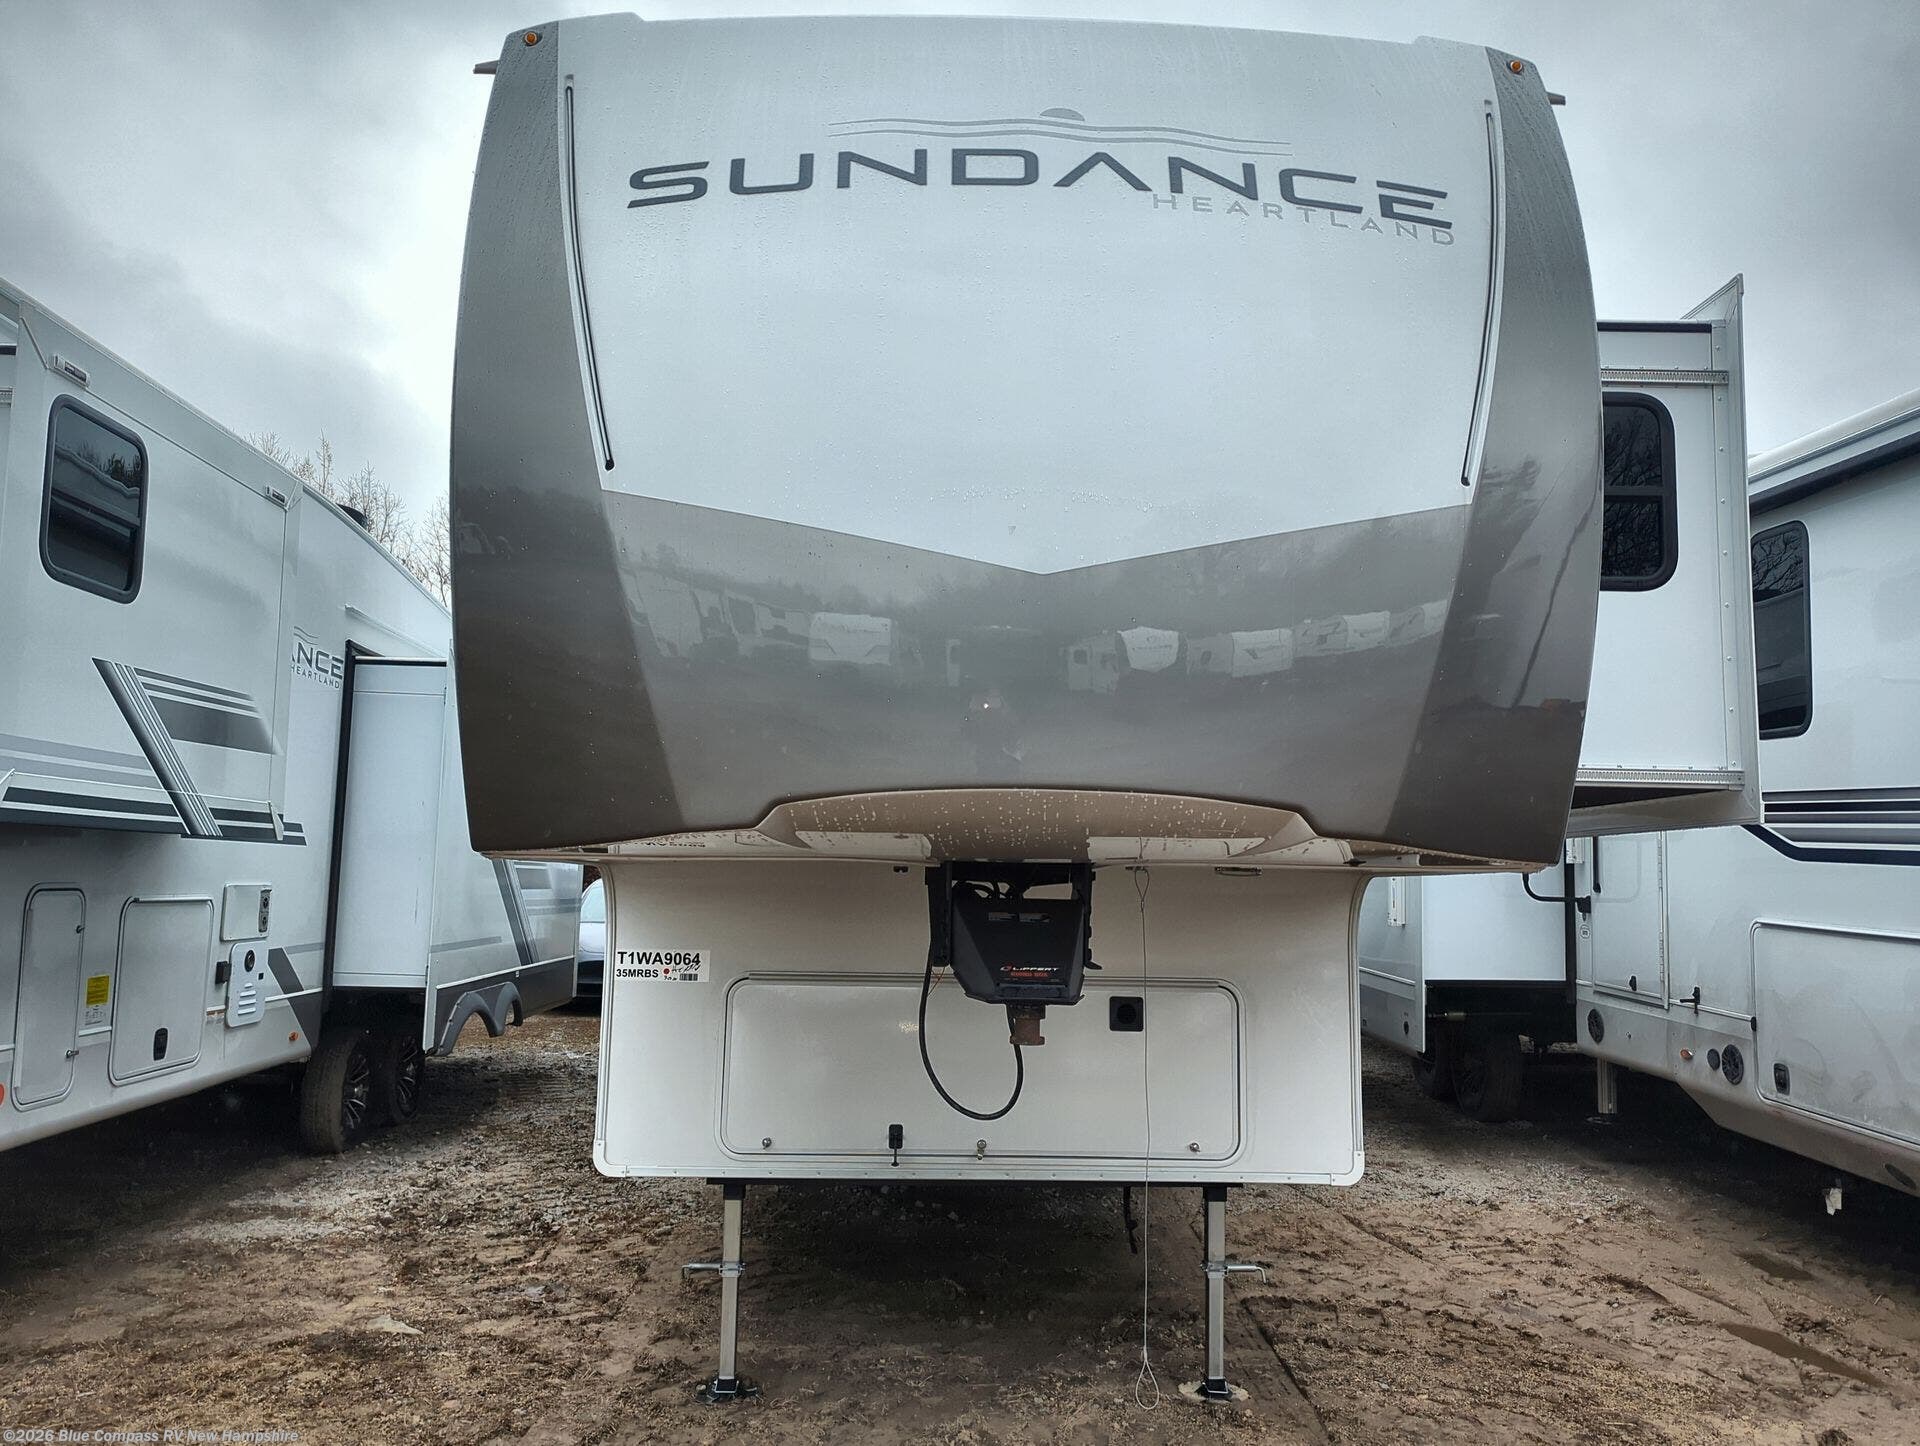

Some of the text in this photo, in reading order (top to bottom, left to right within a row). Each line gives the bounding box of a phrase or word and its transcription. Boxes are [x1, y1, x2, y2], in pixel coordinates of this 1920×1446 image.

[628, 148, 1453, 230] SUNDANCE
[1152, 193, 1455, 246] HEARTLAND
[291, 641, 344, 680] NCE
[616, 968, 660, 978] 35MRBS
[617, 951, 702, 966] T1WA9064
